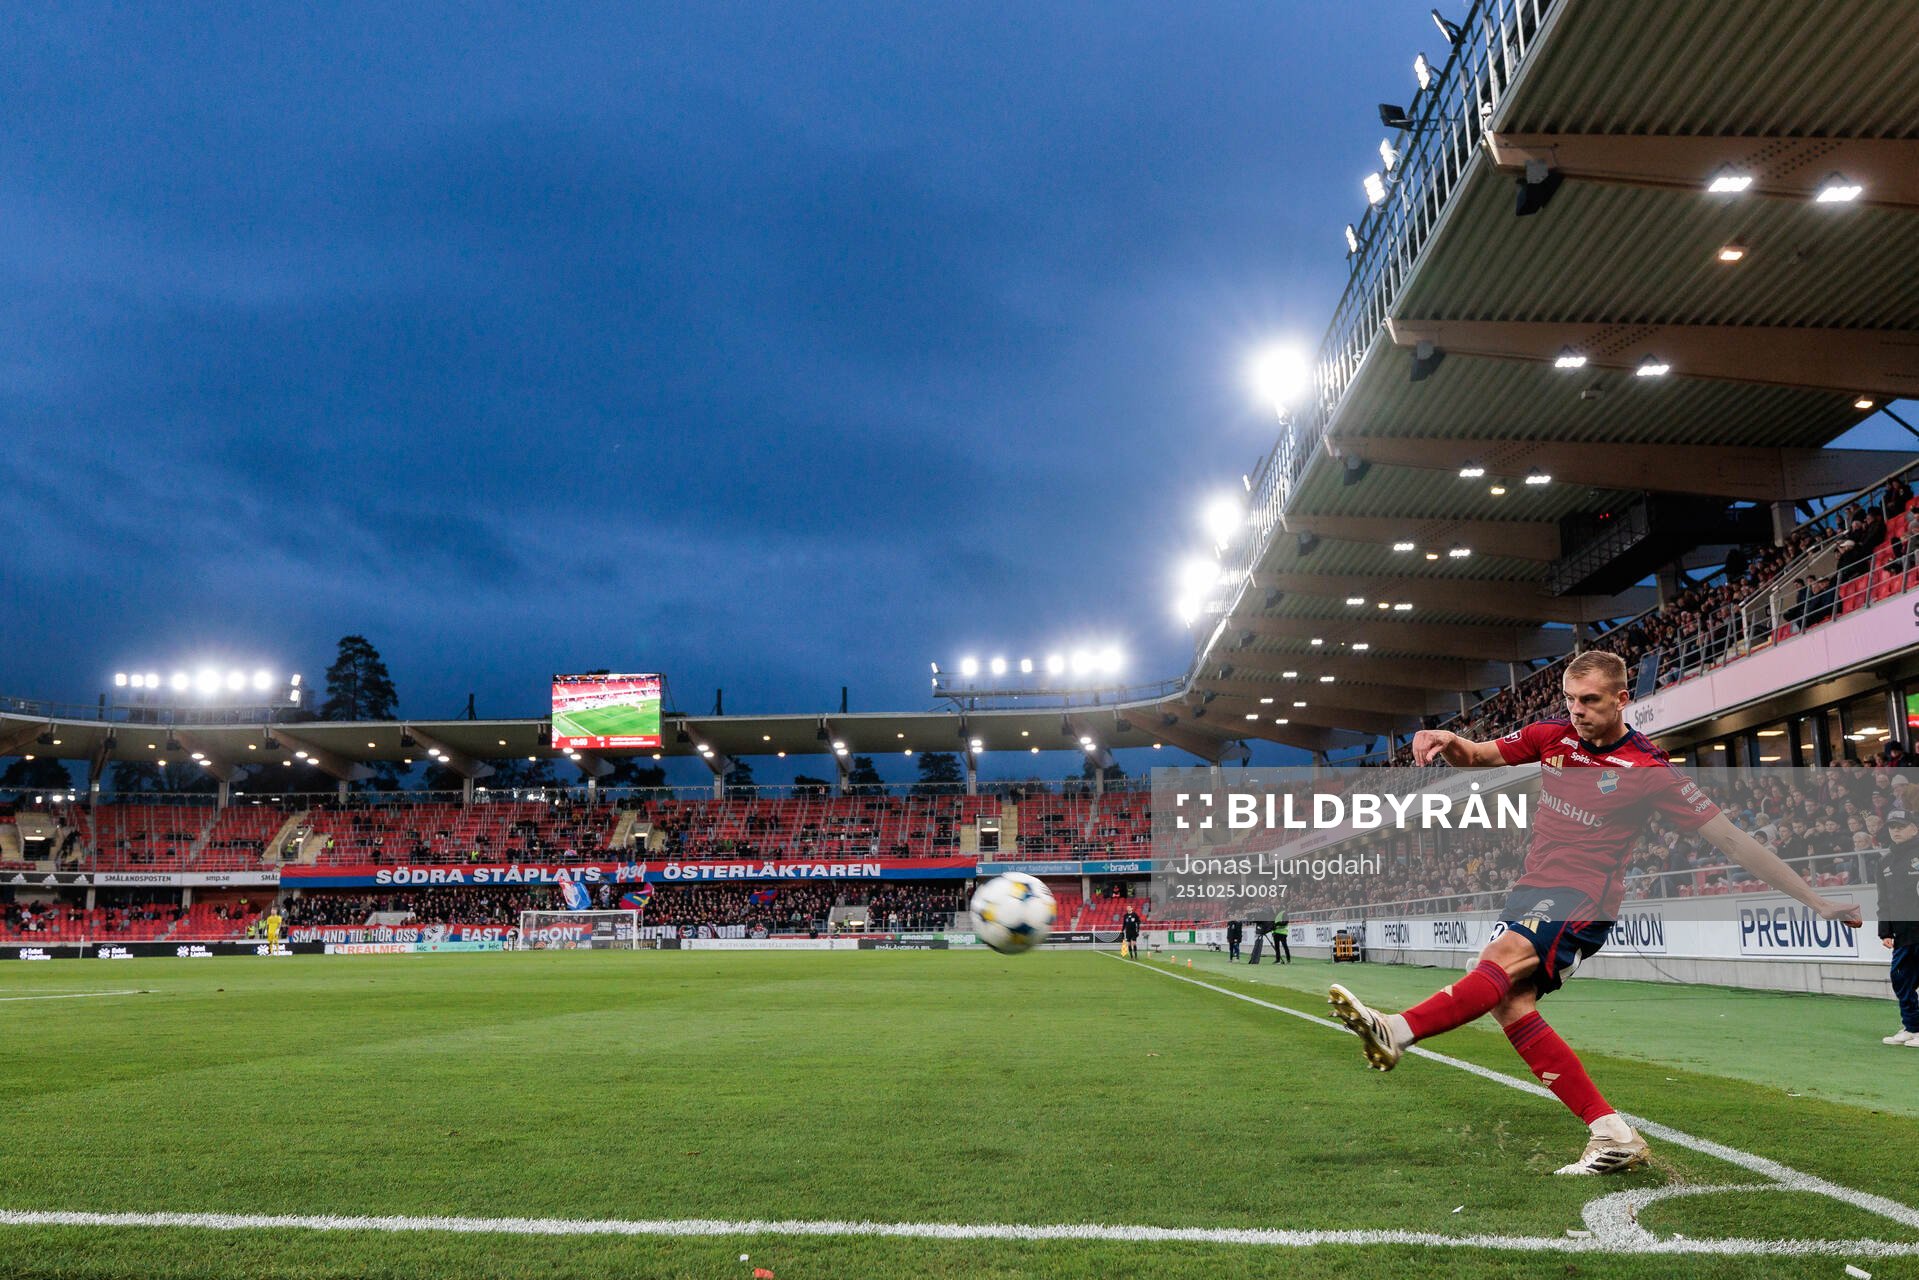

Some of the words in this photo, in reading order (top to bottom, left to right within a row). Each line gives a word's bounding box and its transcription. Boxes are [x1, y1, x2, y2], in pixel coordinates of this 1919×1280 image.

[1635, 704, 1654, 728] Spiris
[1570, 751, 1591, 765] Spiris
[376, 866, 465, 884] SÖDRA
[473, 864, 601, 883] STÅPLATS
[663, 862, 881, 880] ÖSTERLÄKTAREN
[1110, 863, 1139, 873] bravida
[105, 873, 171, 882] SMÅLANDSPOSTEN
[205, 875, 230, 883] smp.se
[396, 928, 418, 943] OSS
[461, 928, 502, 942] EAST
[530, 927, 585, 941] FRONT
[1384, 923, 1410, 945] PREMON
[1434, 920, 1468, 945] PREMON
[1606, 911, 1664, 947] REMON
[1740, 906, 1854, 948] PREMON
